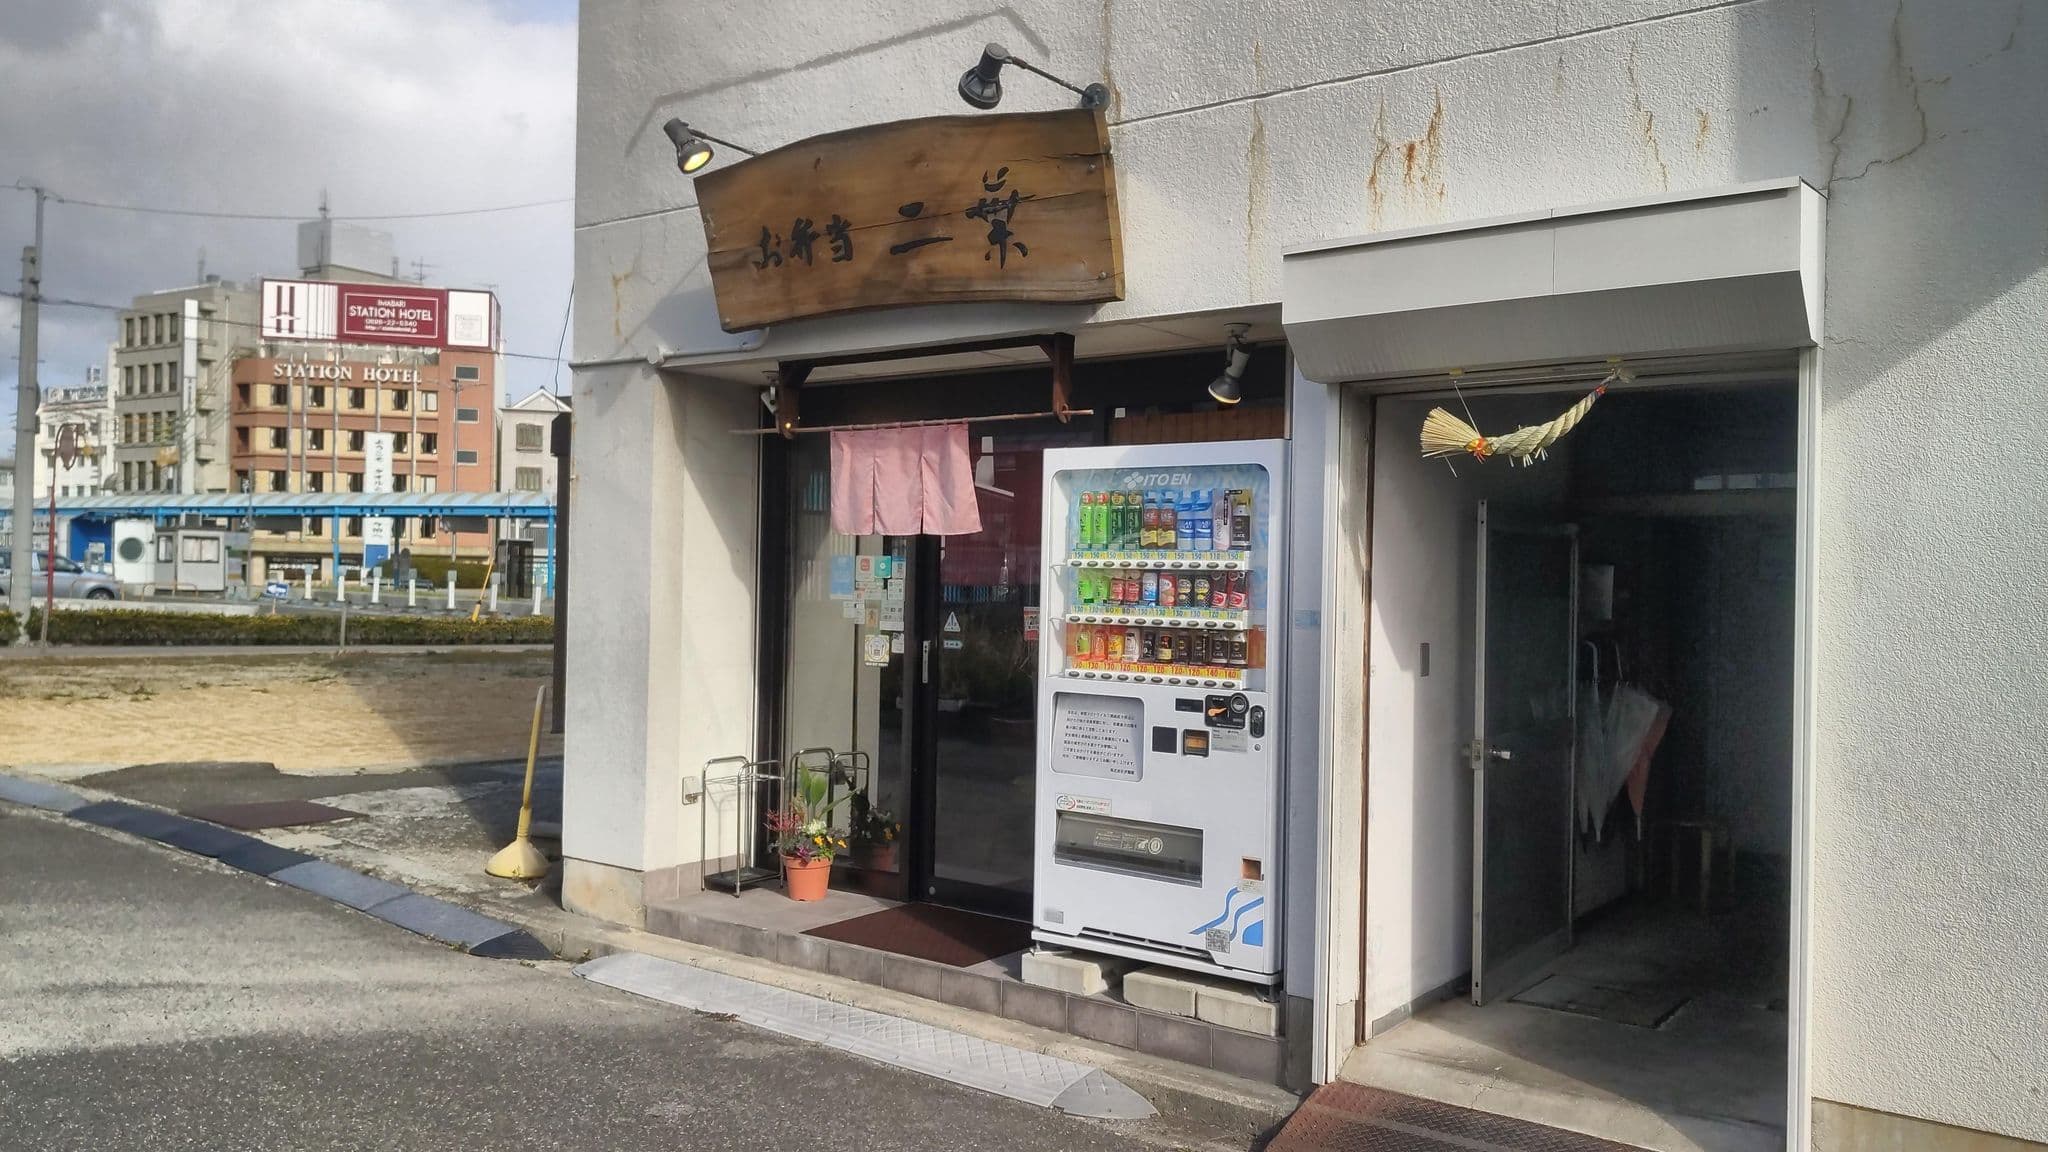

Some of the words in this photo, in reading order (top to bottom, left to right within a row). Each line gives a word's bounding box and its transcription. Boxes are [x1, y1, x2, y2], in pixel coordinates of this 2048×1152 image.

[752, 214, 854, 270] お弁当
[889, 166, 1036, 270] 二葉
[349, 305, 395, 318] STATION
[399, 308, 433, 321] HOTEL
[274, 364, 352, 382] STATION
[363, 367, 422, 384] HOTEL
[1144, 473, 1170, 486] ITO
[1171, 472, 1192, 485] EN
